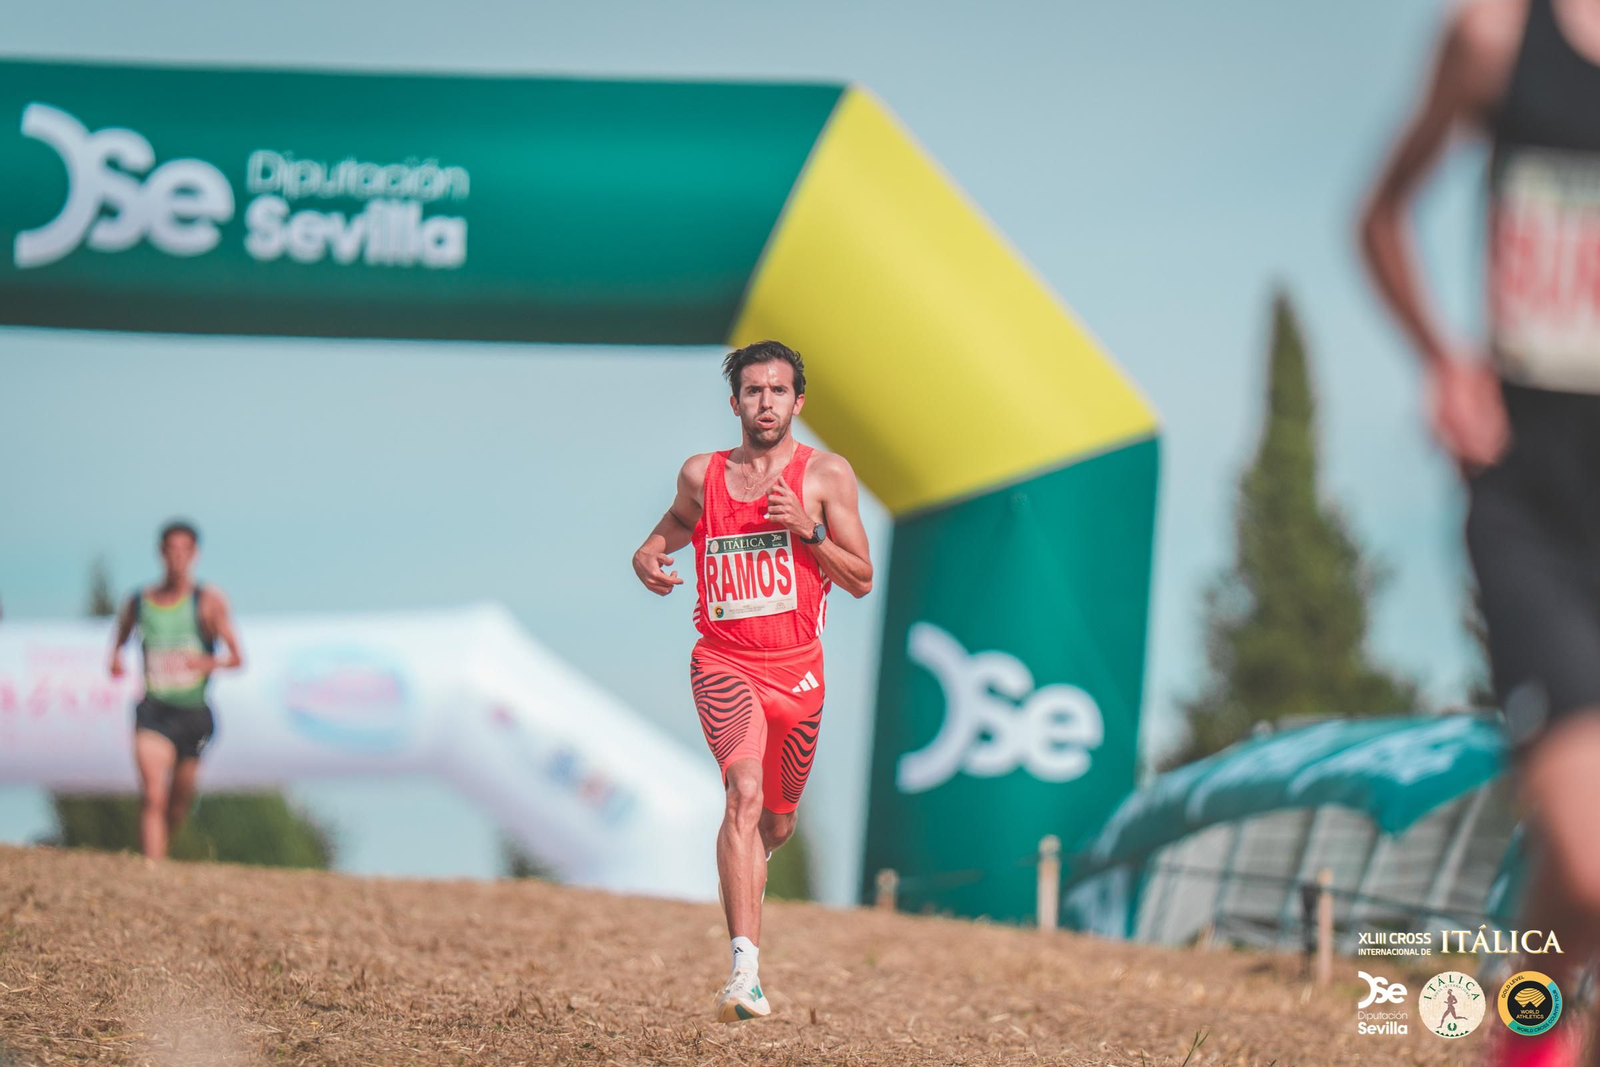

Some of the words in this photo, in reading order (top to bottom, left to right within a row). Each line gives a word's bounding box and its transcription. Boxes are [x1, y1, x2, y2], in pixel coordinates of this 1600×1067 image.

[246, 150, 470, 200] Diputación
[244, 194, 467, 268] Sevilla
[723, 538, 766, 550] ITÁLICA
[706, 548, 792, 603] RAMOS
